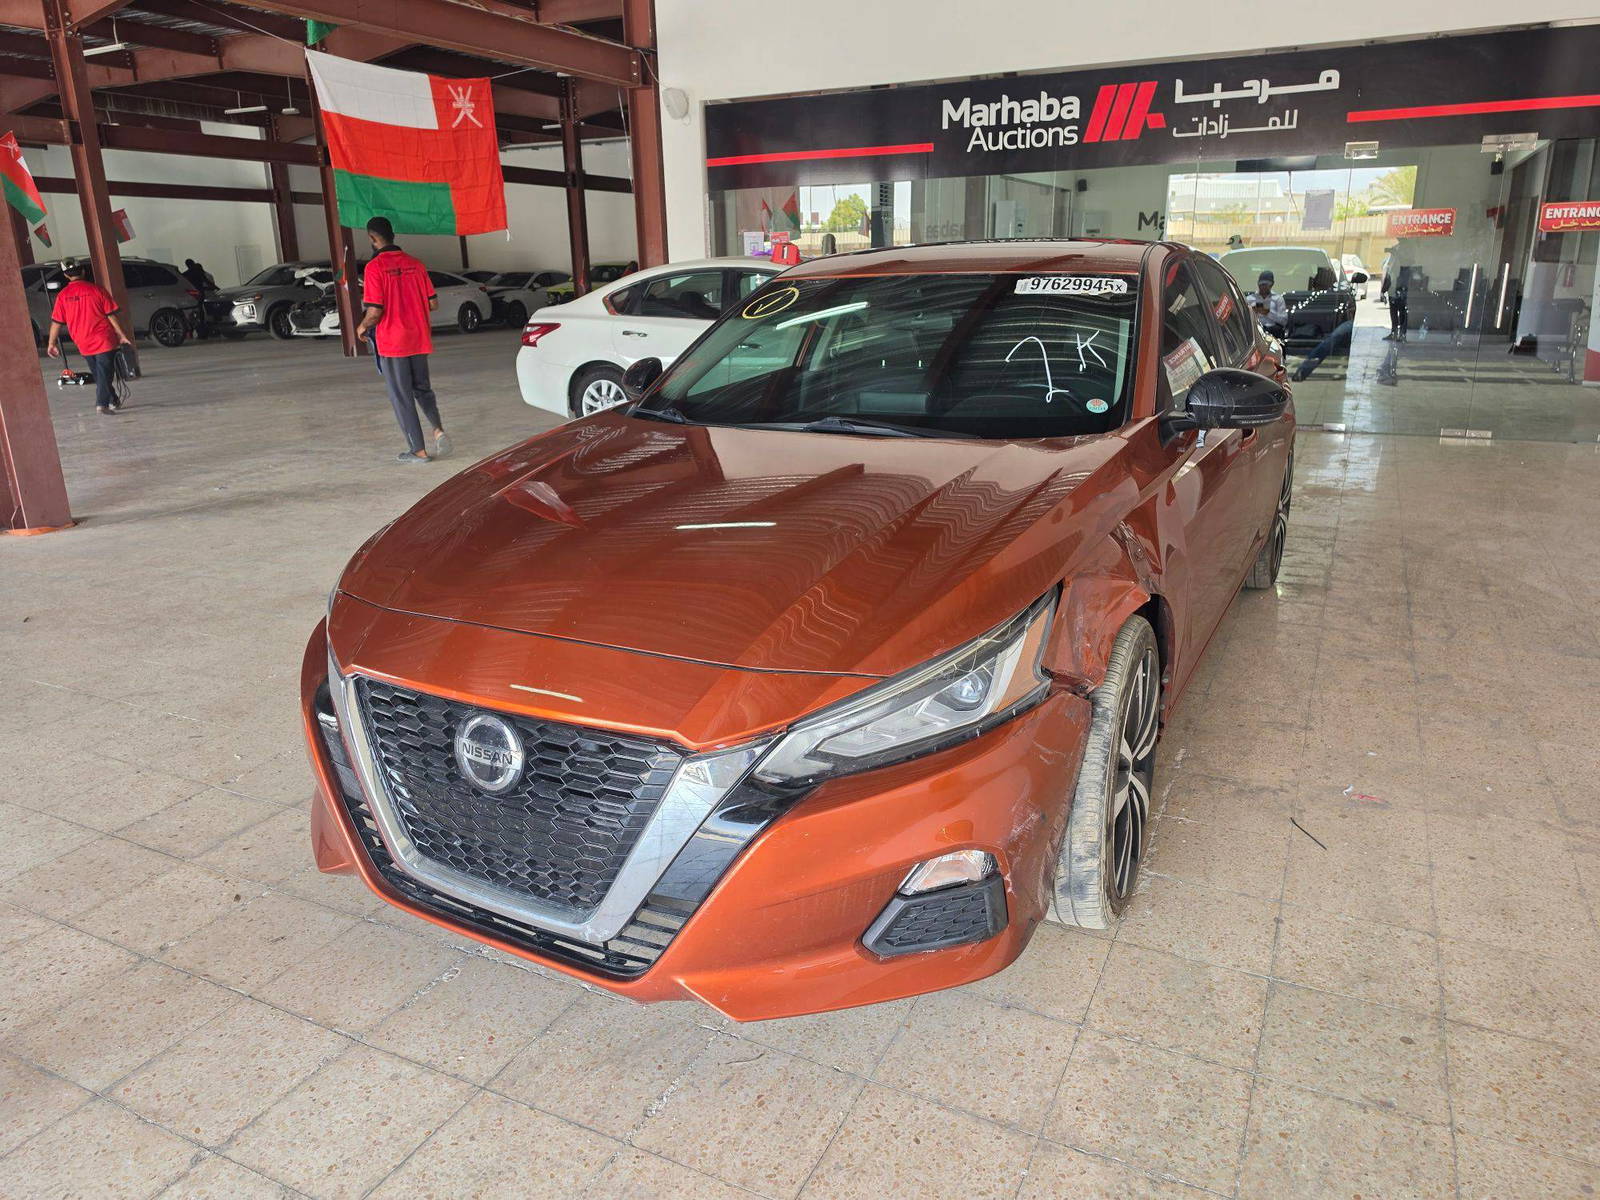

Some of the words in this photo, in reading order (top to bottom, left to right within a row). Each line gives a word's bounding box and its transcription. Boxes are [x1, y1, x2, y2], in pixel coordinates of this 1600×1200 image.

[1174, 69, 1340, 108] مرحبا
[942, 90, 1080, 130] Marhaba
[1172, 109, 1299, 139] للمزادات
[966, 123, 1079, 153] Auctions
[1392, 213, 1452, 225] ENTRANCE
[462, 742, 513, 765] NISSAN
